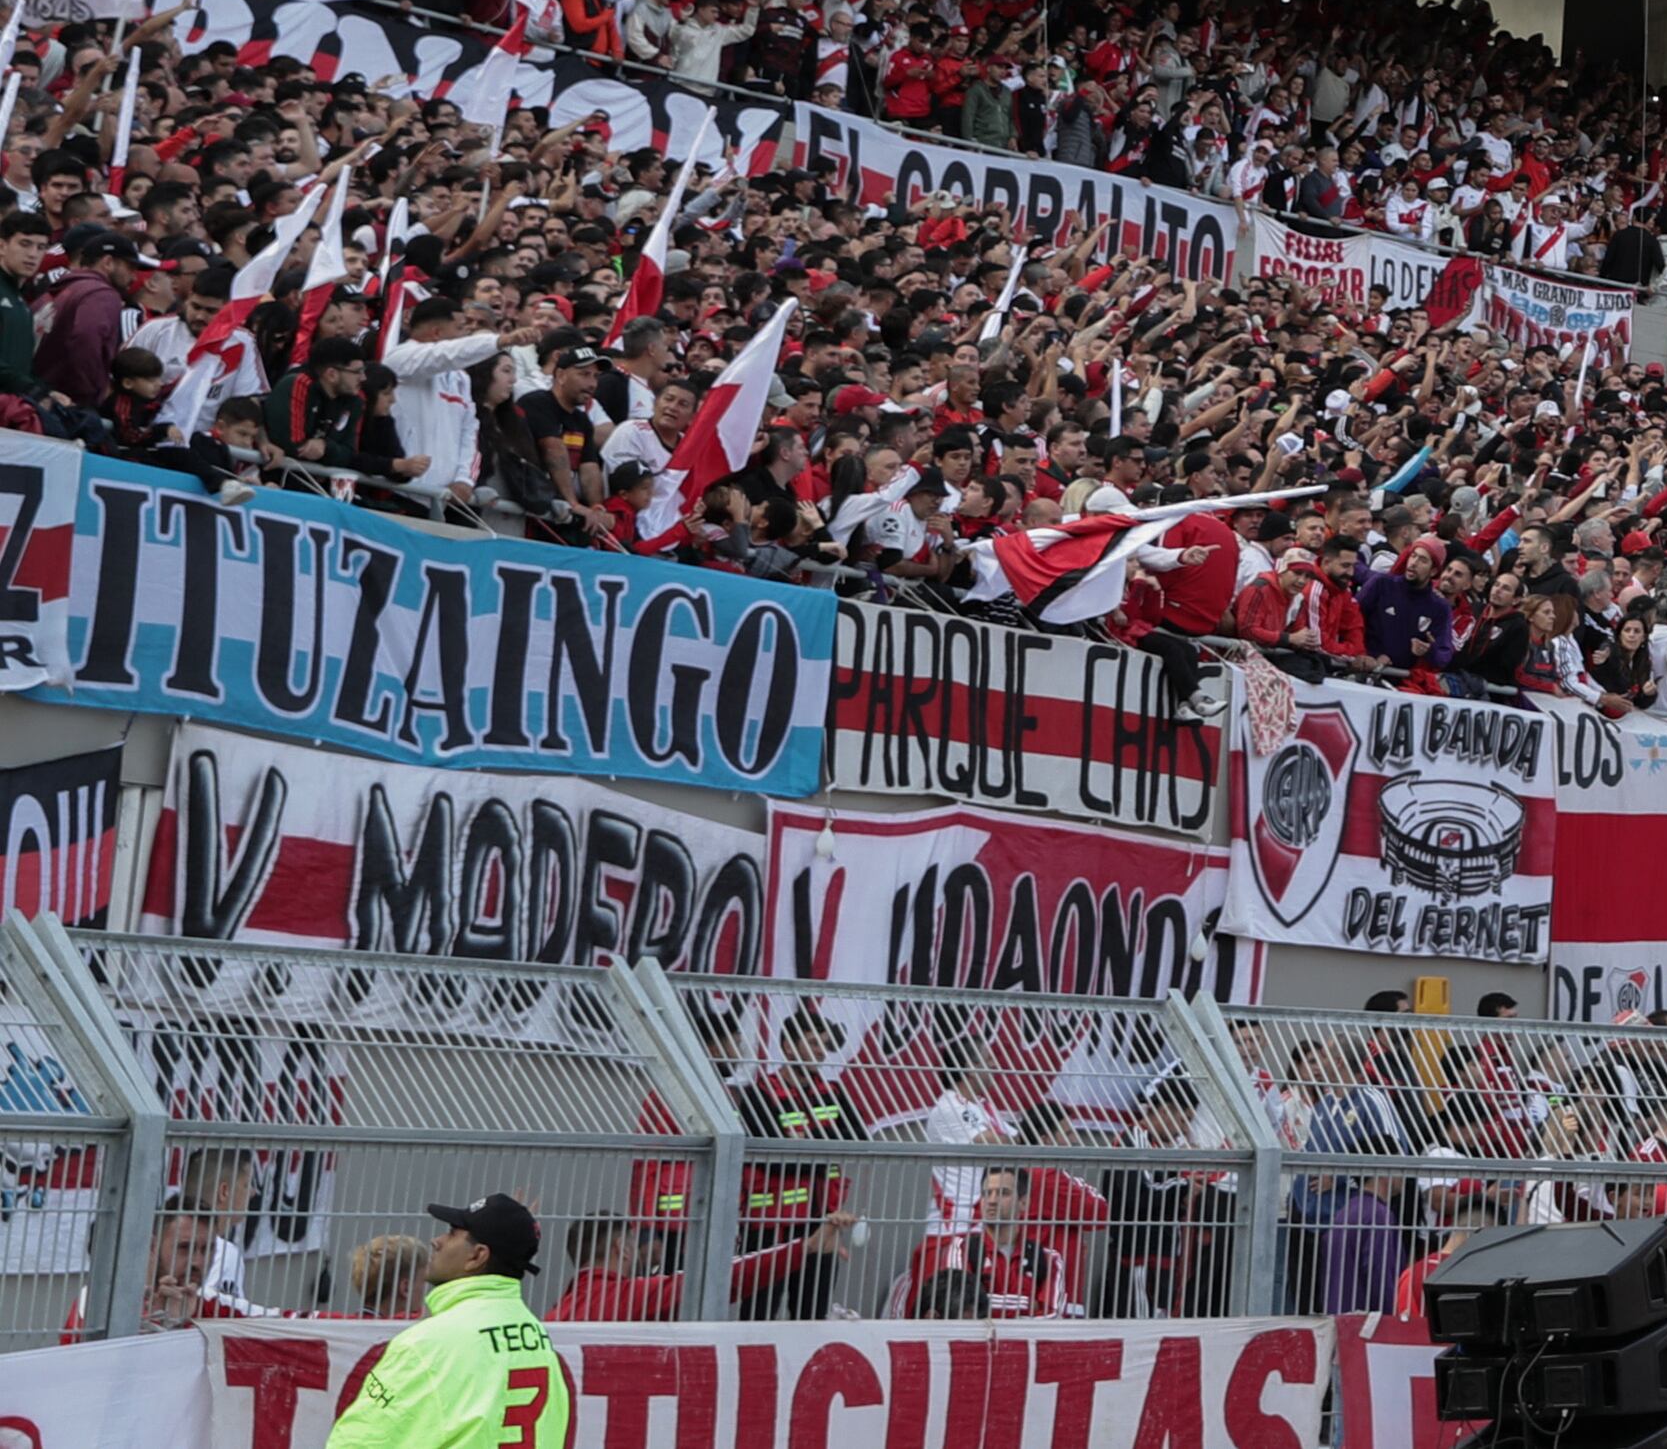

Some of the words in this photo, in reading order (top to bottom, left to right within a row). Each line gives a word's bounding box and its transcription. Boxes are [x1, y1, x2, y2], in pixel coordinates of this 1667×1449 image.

[806, 110, 862, 207] EL
[1285, 230, 1345, 264] FILIAL
[1595, 290, 1633, 312] LEJOS
[75, 480, 799, 777] ITUZAINGO
[826, 607, 1053, 809] PARQUE
[1080, 645, 1226, 831] CHAS
[1367, 699, 1414, 770] LA
[1423, 702, 1547, 782] BANDA
[1555, 710, 1624, 791] LOS
[1342, 887, 1408, 951] DEL
[1413, 898, 1551, 960] FERNET
[497, 1366, 549, 1449] 3
